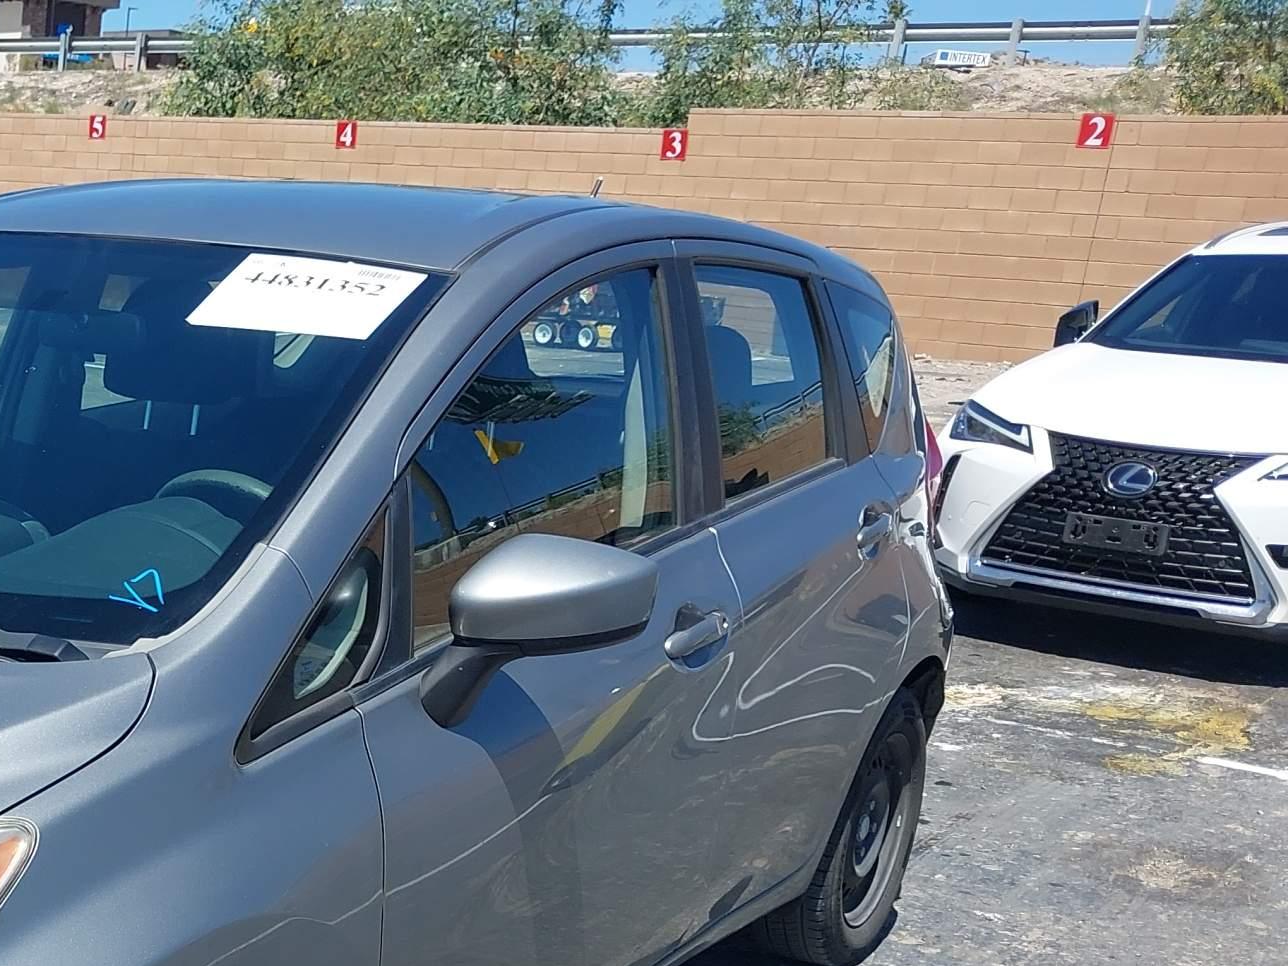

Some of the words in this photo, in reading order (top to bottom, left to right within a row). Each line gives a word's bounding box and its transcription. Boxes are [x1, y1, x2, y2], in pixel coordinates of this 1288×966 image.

[949, 52, 987, 65] INTERTEX
[92, 116, 103, 138] 5
[339, 121, 353, 147] 4
[1083, 116, 1105, 146] 2
[665, 131, 682, 158] 3
[245, 271, 386, 297] 44831352
